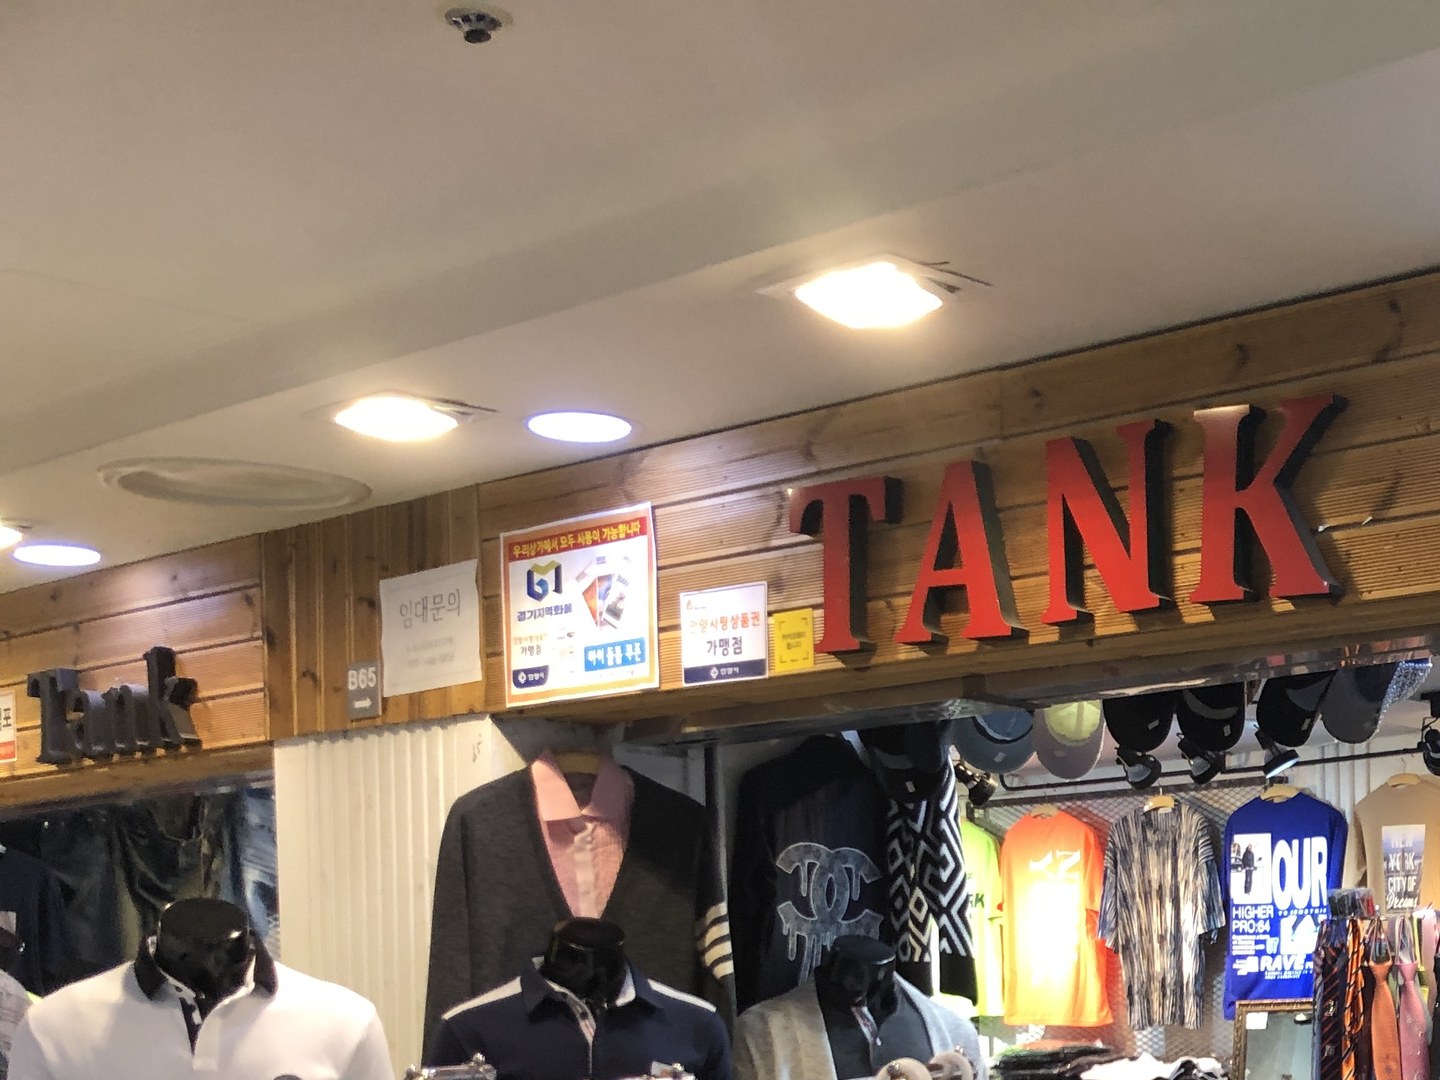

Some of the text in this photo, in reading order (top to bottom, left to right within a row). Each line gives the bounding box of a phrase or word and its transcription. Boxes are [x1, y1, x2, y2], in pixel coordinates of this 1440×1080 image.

[789, 393, 1347, 655] TANK
[399, 588, 461, 629] 임대문의
[706, 635, 743, 657] 가맹점
[347, 666, 377, 691] B65
[26, 646, 203, 766] Tank
[1387, 876, 1417, 893] CITY OF
[1232, 905, 1275, 919] HIGHER
[1386, 892, 1418, 910] Dreams
